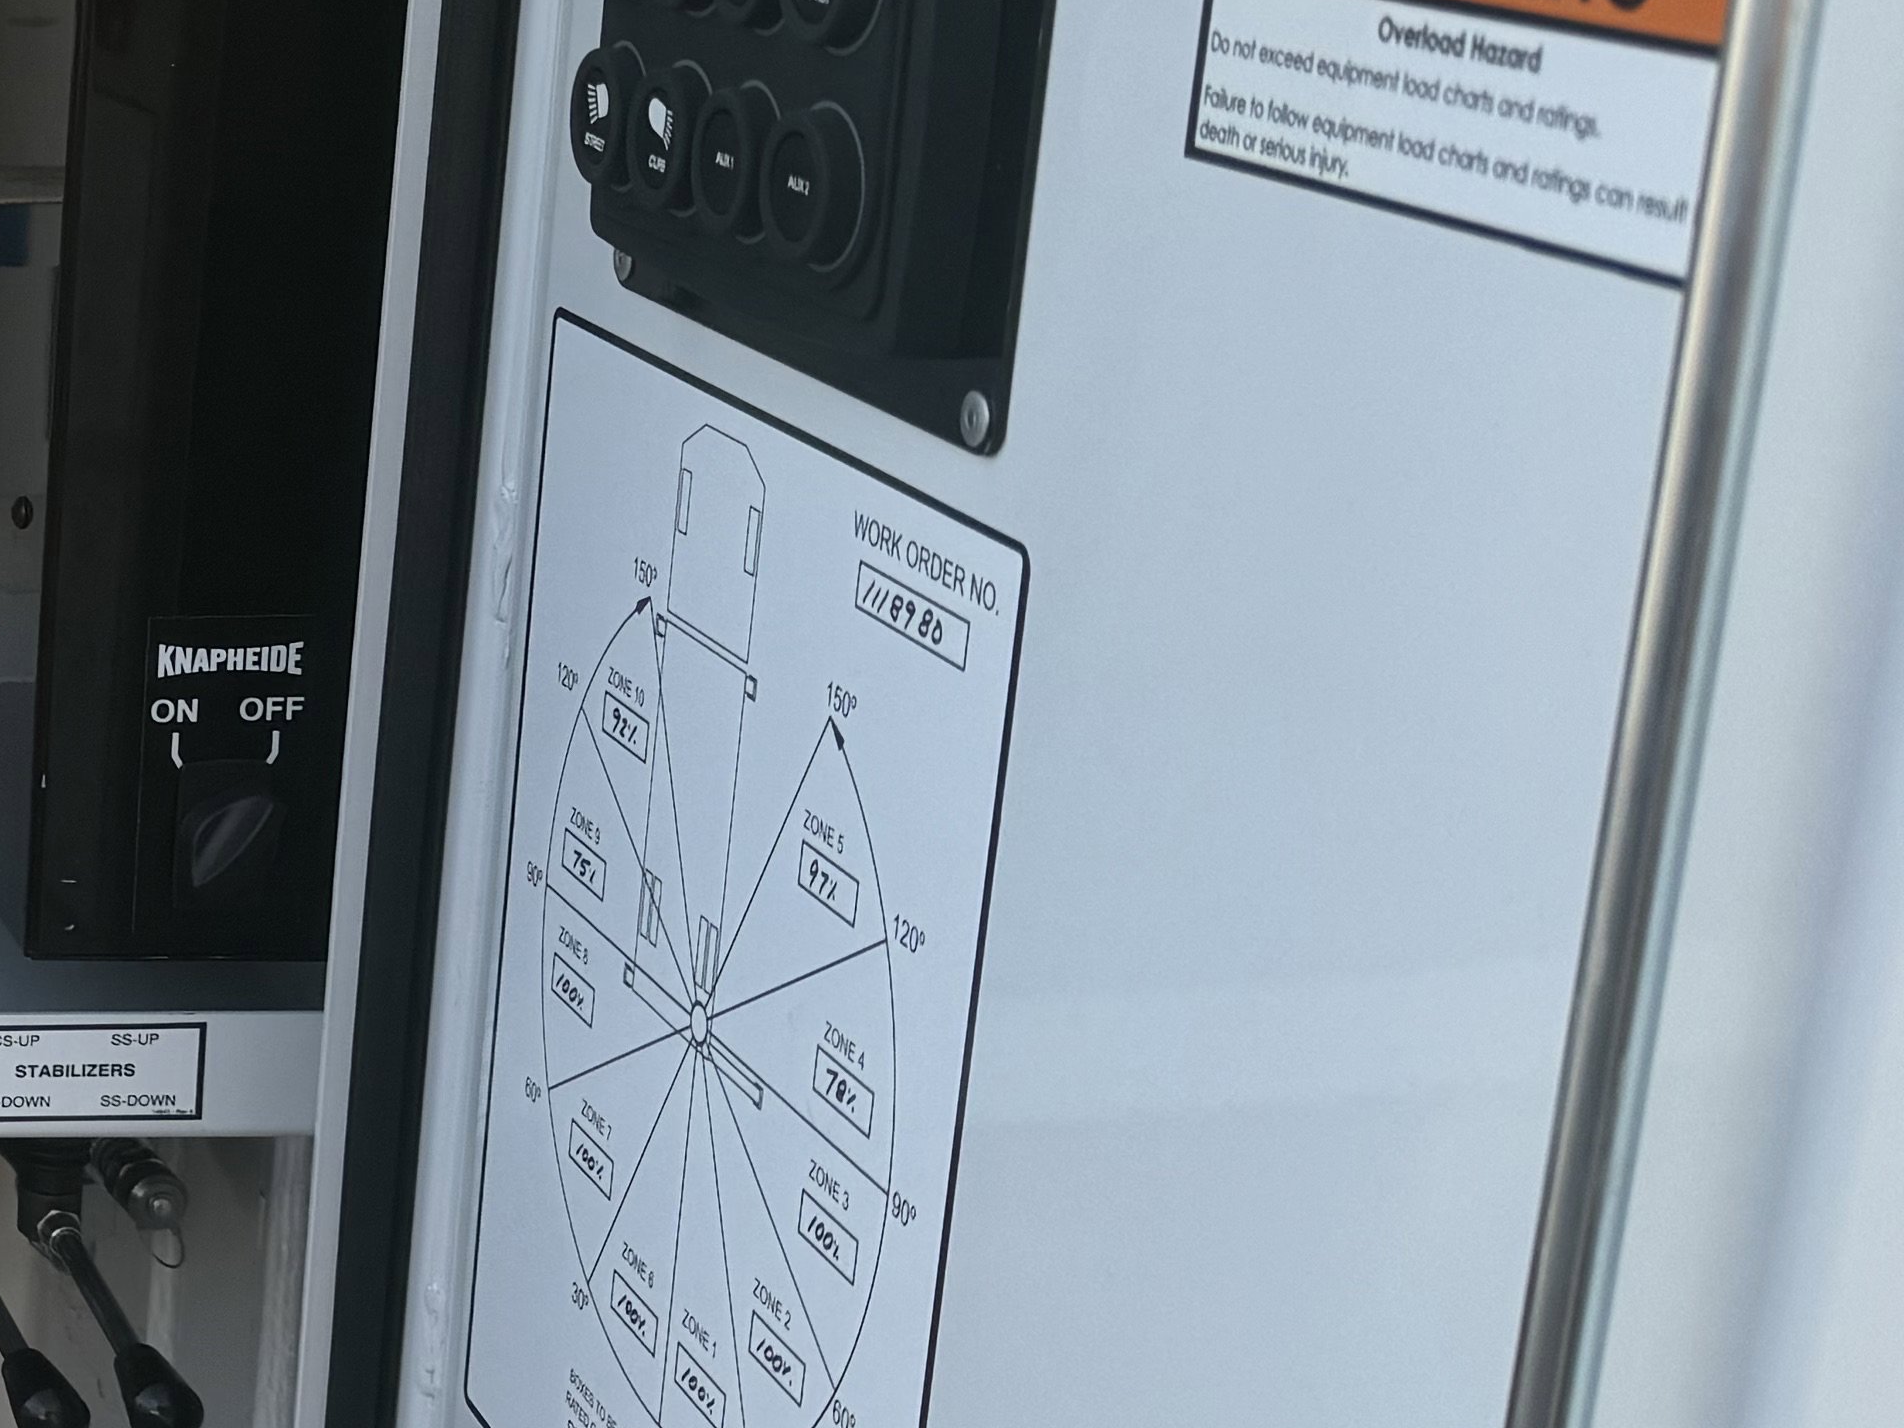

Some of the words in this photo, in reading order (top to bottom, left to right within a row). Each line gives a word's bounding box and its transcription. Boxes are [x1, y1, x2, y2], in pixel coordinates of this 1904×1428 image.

[1377, 15, 1466, 58] Overload
[1470, 33, 1543, 74] Hazard
[1210, 29, 1230, 55] Do
[1232, 39, 1256, 60] not
[1258, 45, 1314, 73] exceed
[1316, 57, 1400, 91] equipment
[1402, 72, 1440, 101] load
[1442, 83, 1494, 114] charts
[1497, 98, 1535, 123] and
[1536, 105, 1599, 138] ratings.
[715, 151, 730, 168] AUX
[731, 156, 734, 169] 1
[1198, 118, 1240, 147] death
[1242, 133, 1257, 152] or
[1259, 136, 1306, 165] serious
[1308, 145, 1348, 179] injury.
[1203, 83, 1246, 115] Failure
[1249, 95, 1264, 119] to
[1267, 98, 1309, 129] follow
[1311, 114, 1399, 151] equipment
[1397, 131, 1435, 161] load
[1437, 143, 1488, 175] charts
[1492, 159, 1529, 185] and
[1531, 168, 1590, 202] ratings
[1594, 184, 1633, 208] can
[788, 175, 803, 193] AUX
[803, 181, 810, 195] 2
[855, 510, 902, 561] WORK
[906, 540, 965, 597] ORDER
[970, 573, 999, 616] NO.
[863, 579, 943, 645] 1118980
[158, 641, 304, 679] KNAPHEIDE
[607, 666, 631, 699] ZONE
[826, 681, 857, 719] 150°
[151, 698, 198, 723] ON
[239, 697, 305, 721] OFF
[570, 806, 593, 838] ZONE
[594, 827, 600, 845] 9
[803, 809, 835, 849] ZONE
[836, 833, 844, 854] 5
[558, 925, 580, 957] ZONE
[893, 913, 926, 956] 120°
[111, 1033, 160, 1046] SS-UP
[824, 1020, 855, 1063] ZONE
[857, 1050, 866, 1072] 4
[15, 1063, 136, 1078] STABILIZERS
[100, 1094, 176, 1108] SS-DOWN
[581, 1098, 605, 1133] ZONE
[605, 1121, 613, 1143] 7
[808, 1158, 839, 1201] ZONE
[841, 1190, 850, 1211] 3
[892, 1191, 917, 1226] 90°
[622, 1240, 648, 1281] ZONE
[571, 1280, 589, 1312] 30°
[752, 1277, 781, 1321] ZONE
[782, 1308, 792, 1331] 2
[681, 1308, 709, 1347] ZONE
[711, 1337, 718, 1359] 1
[570, 1368, 594, 1408] BOXES
[596, 1399, 606, 1422] TO
